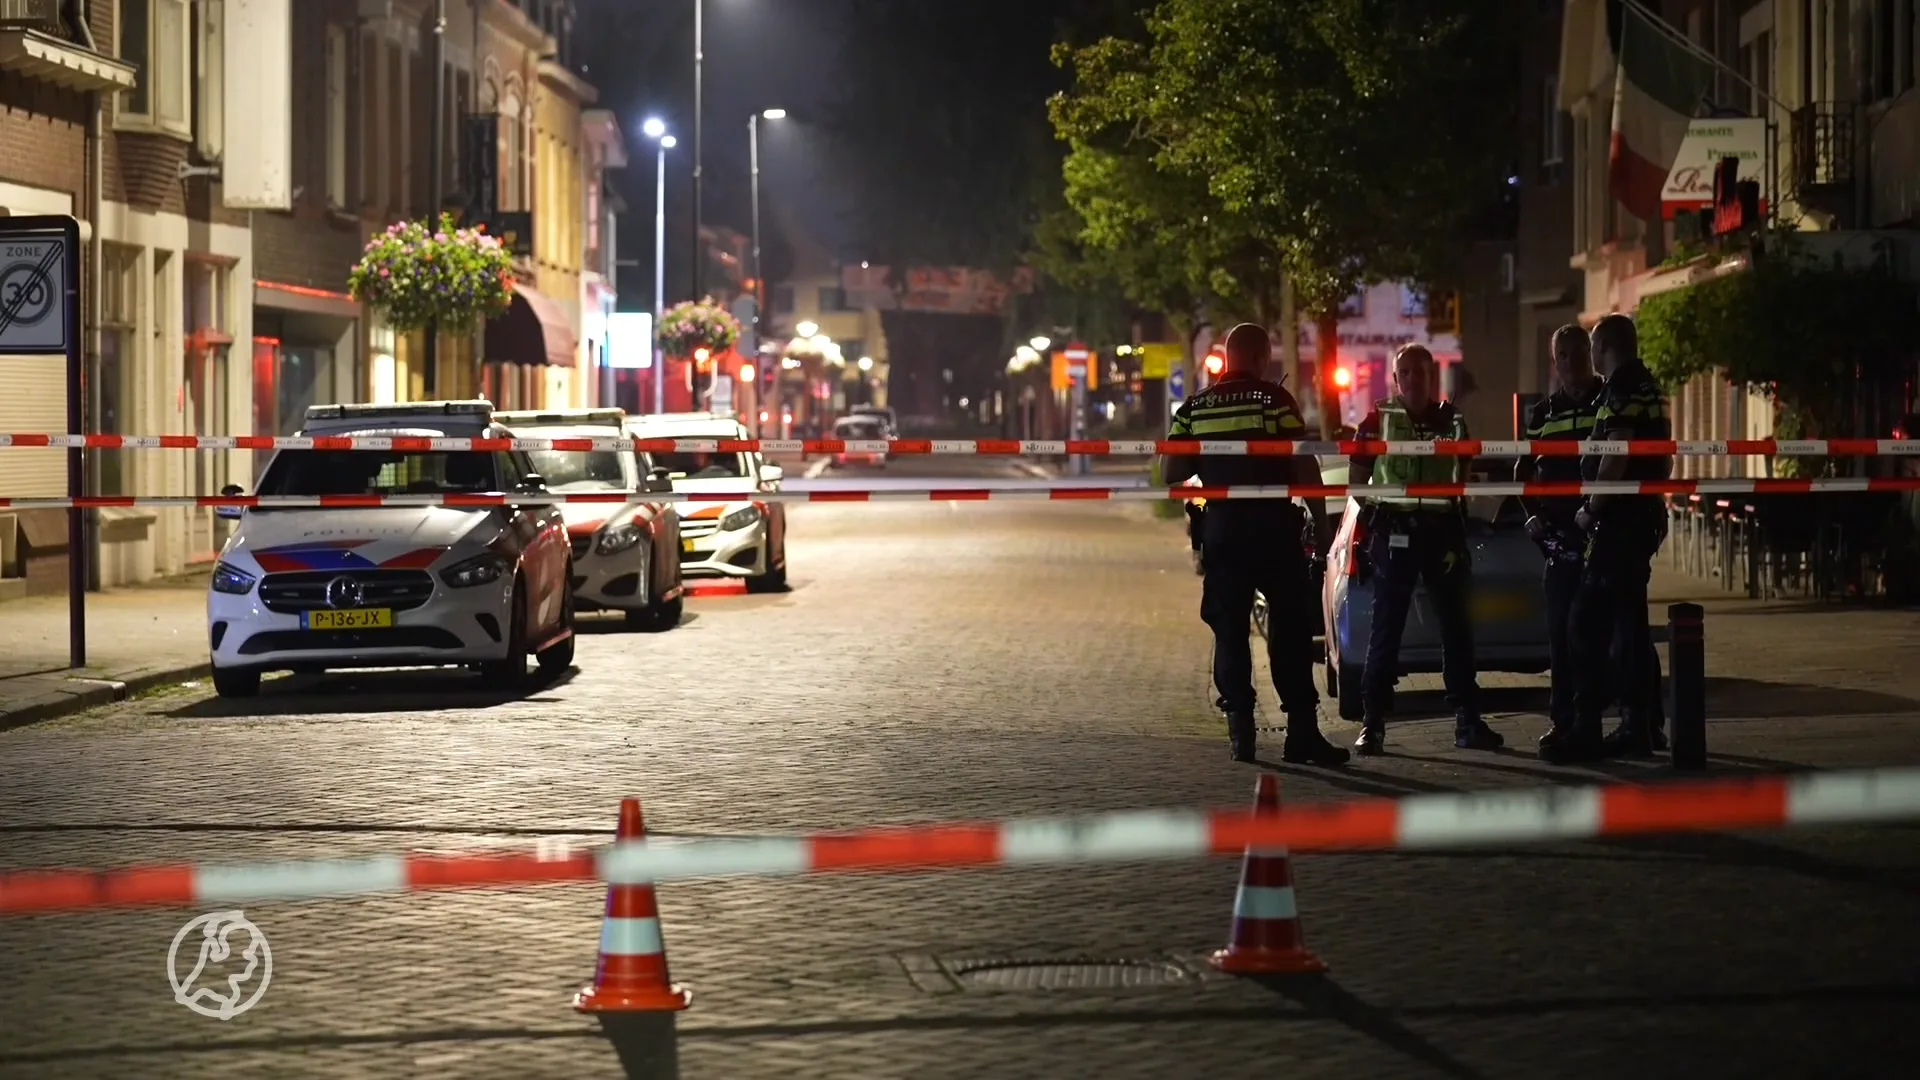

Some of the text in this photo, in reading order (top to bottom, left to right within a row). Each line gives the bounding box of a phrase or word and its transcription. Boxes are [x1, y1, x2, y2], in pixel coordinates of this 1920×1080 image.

[6, 246, 42, 257] ZONE
[6, 283, 44, 306] 30
[315, 610, 381, 627] P-136-JX
